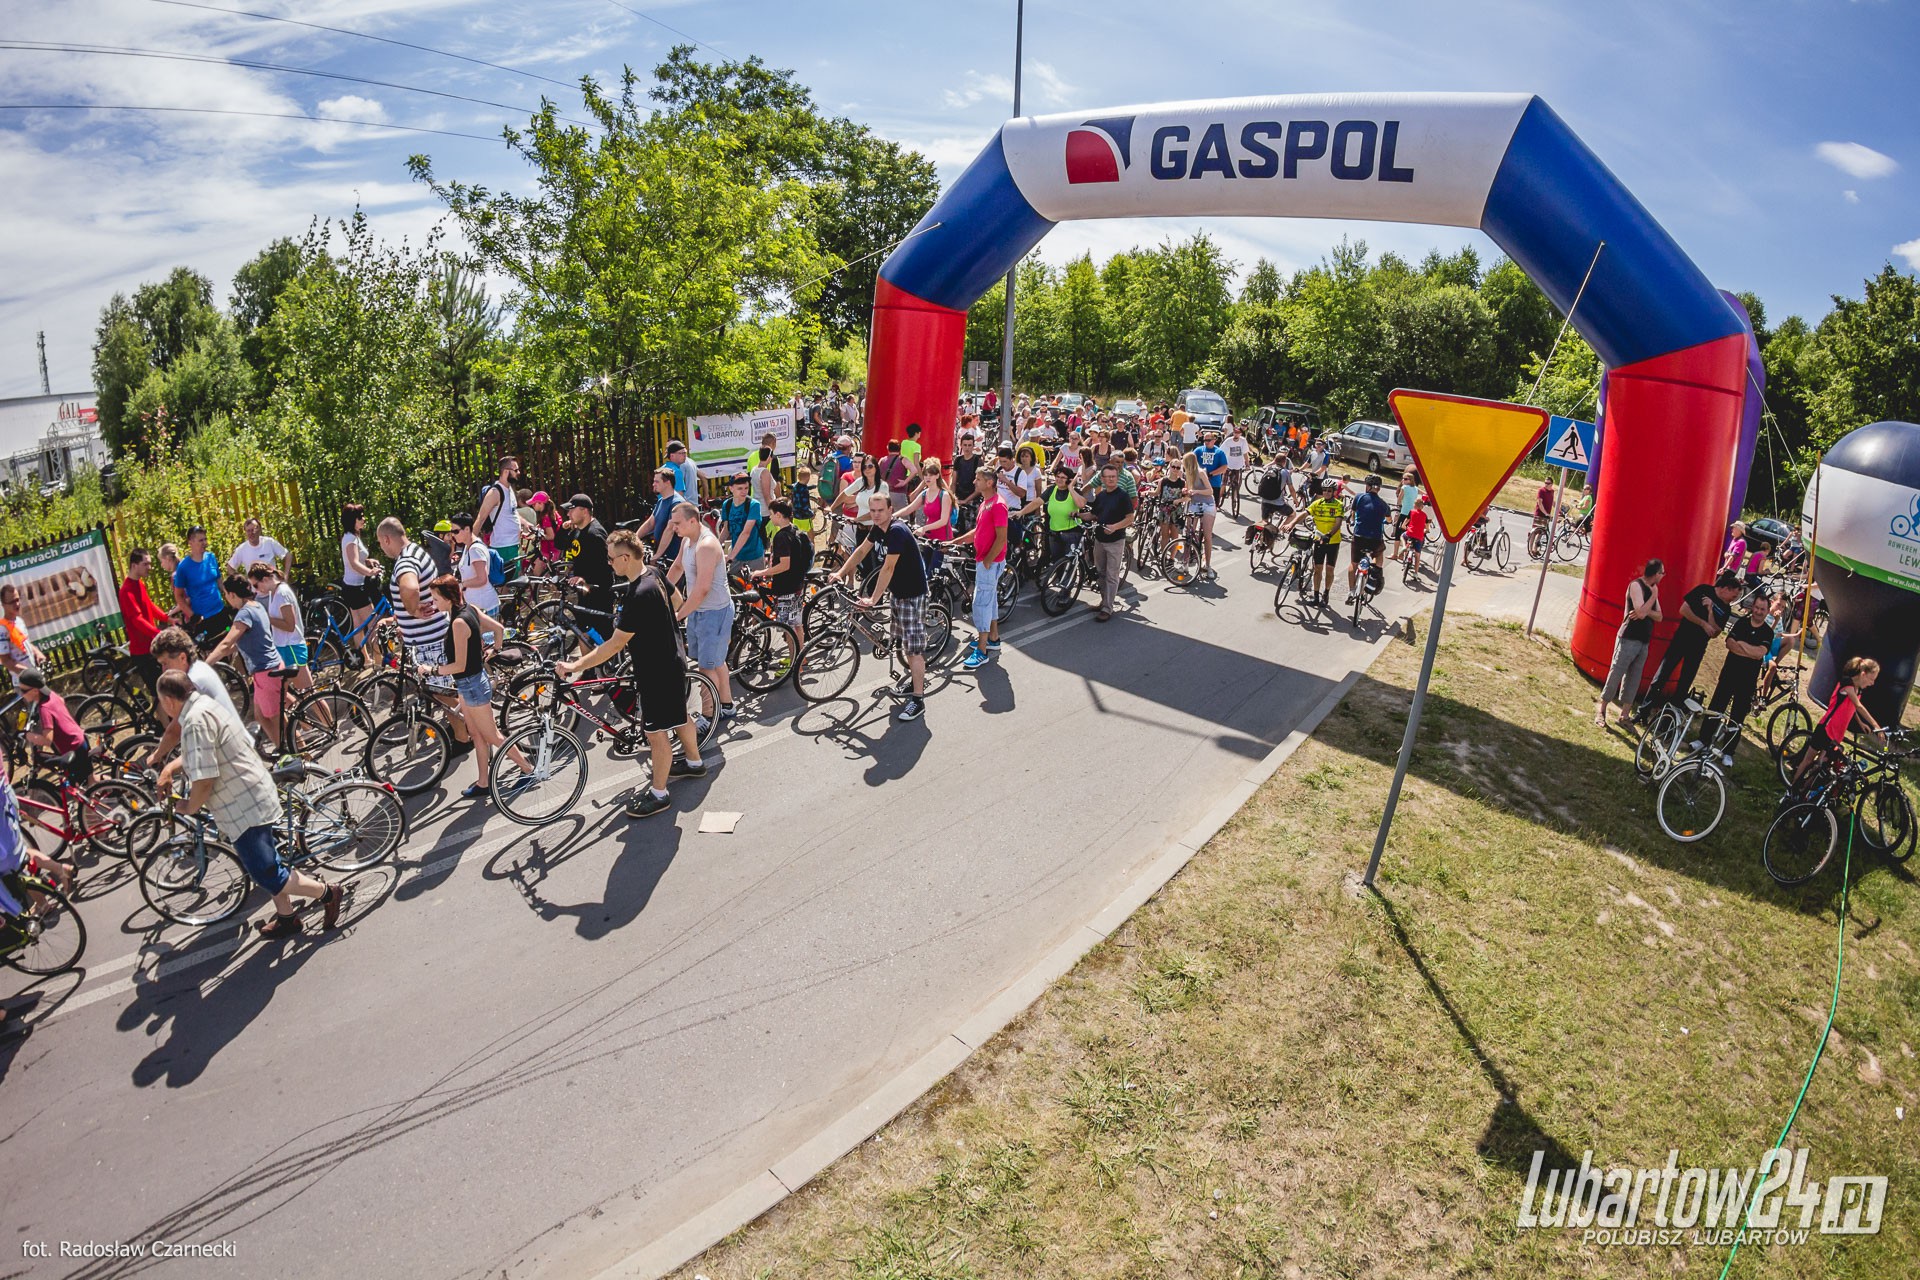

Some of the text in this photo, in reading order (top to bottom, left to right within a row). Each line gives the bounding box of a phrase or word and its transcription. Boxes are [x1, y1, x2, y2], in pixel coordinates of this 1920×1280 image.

[1150, 120, 1415, 184] GASPOL
[707, 424, 733, 432] STREFA
[753, 420, 769, 430] MAMY
[708, 429, 745, 440] LUBARTÓW
[9, 547, 59, 570] barwach
[60, 535, 93, 555] Ziemi
[1887, 540, 1918, 554] ROWEREM
[1887, 575, 1920, 591] www.luba
[37, 631, 76, 651] kier.pl
